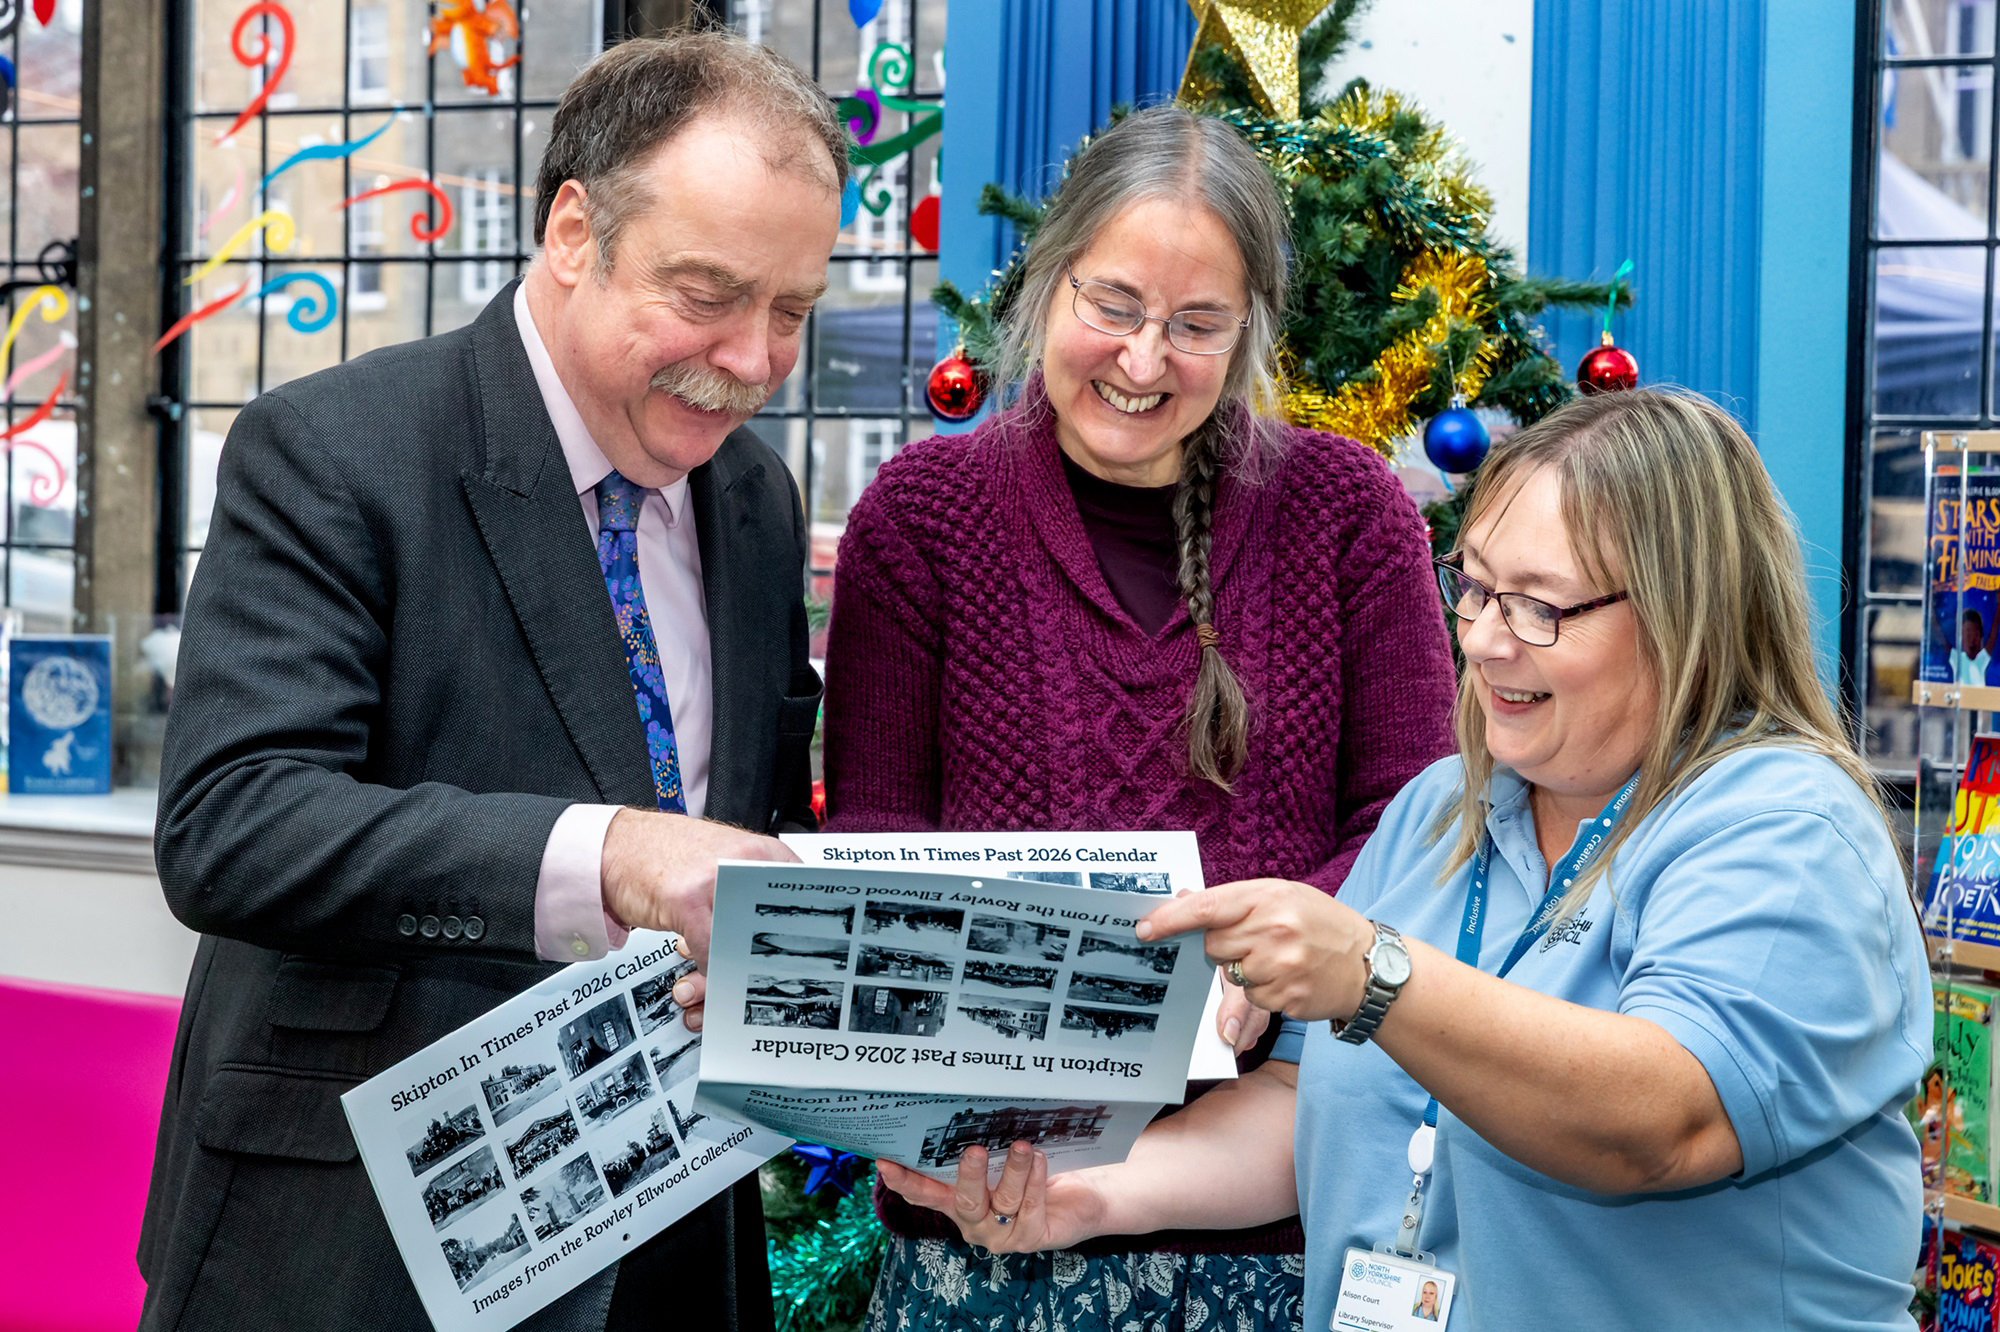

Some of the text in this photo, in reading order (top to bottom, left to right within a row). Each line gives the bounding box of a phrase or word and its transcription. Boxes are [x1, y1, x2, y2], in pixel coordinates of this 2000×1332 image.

[823, 848, 1158, 863] Skipton In Times Past 2026 Calendar
[1572, 833, 1602, 871] Creative
[767, 882, 861, 895] Collection
[866, 887, 944, 901] Ellwood
[948, 892, 1022, 912] Rowley
[1026, 903, 1055, 917] the
[1061, 909, 1110, 926] from
[1466, 896, 1481, 935] Inclusive
[391, 938, 679, 1112] Skipton In Times Past 2026 Calenda
[752, 1039, 1143, 1078] Skipton In Times Past 2026 Calendar
[749, 1089, 831, 1104] Skipton
[836, 1094, 858, 1103] in
[745, 1097, 808, 1112] Images
[811, 1106, 857, 1114] from
[862, 1103, 889, 1112] the
[894, 1097, 960, 1109] Rowley
[472, 1275, 523, 1314] Images
[524, 1252, 560, 1284] from
[560, 1236, 583, 1257] the
[584, 1203, 633, 1242] Rowley
[636, 1164, 690, 1208] Ellwood
[690, 1126, 753, 1171] Collection
[1367, 1269, 1402, 1284] YORKSHIRE
[1368, 1263, 1391, 1273] NORTH
[1941, 1253, 1995, 1298] JOKES
[1365, 1275, 1393, 1288] COUNCIL
[1342, 1290, 1380, 1305] Alison Court
[1338, 1311, 1394, 1330] Library Supervisor
[1940, 1293, 1991, 1332] FUNNY
